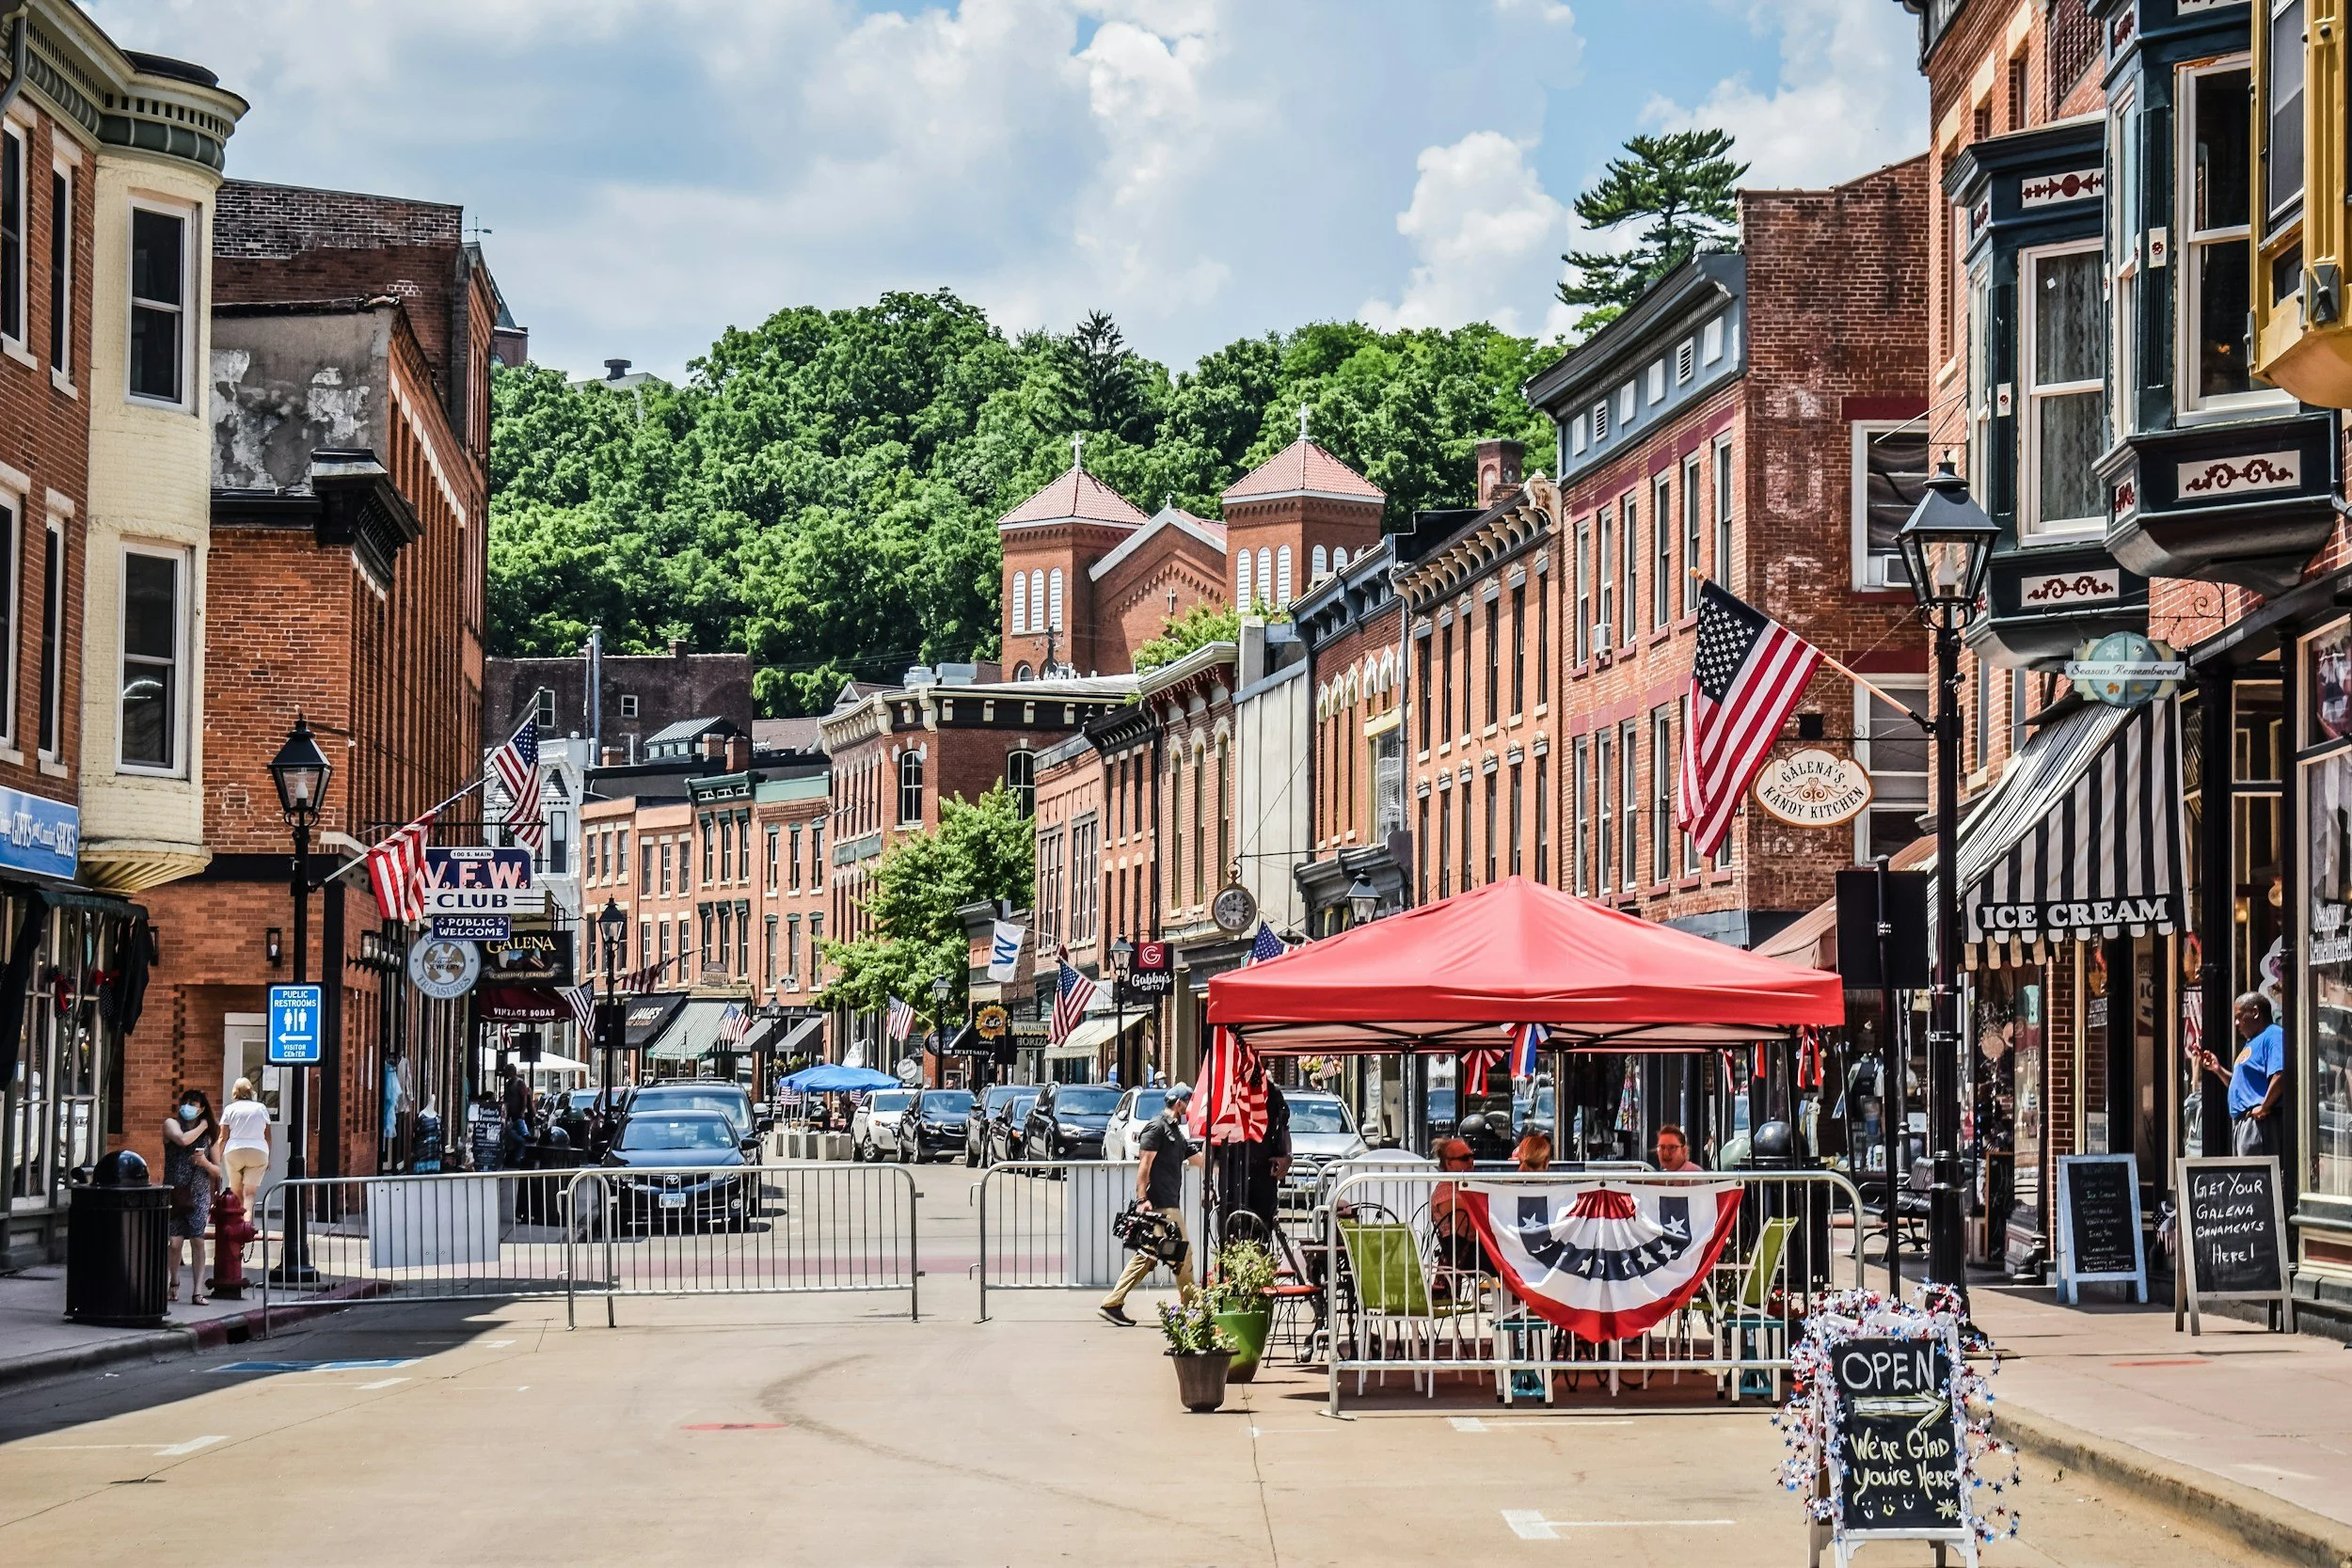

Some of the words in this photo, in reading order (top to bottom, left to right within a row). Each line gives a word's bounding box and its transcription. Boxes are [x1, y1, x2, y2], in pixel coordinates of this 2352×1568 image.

[2071, 664, 2110, 676] Seasons
[2112, 664, 2183, 676] Remembered
[1781, 761, 1845, 784] GALENA'S
[1762, 785, 1805, 816] KANDY
[1810, 785, 1865, 818] KITCHEN
[11, 811, 32, 848] GIFTS
[55, 821, 75, 858] SHOES
[437, 894, 508, 909] CLUB
[447, 918, 496, 927] PUBLIC
[1981, 905, 2038, 929] ICE
[2046, 897, 2169, 927] CREAM
[438, 927, 503, 937] WELCOME
[485, 936, 557, 955] GALENA
[416, 974, 471, 996] TREASURES
[1131, 971, 1172, 991] Gabby's
[282, 990, 309, 999] PUBLIC
[493, 1006, 527, 1017] VINTAGE
[530, 1008, 556, 1017] SODAS
[2194, 1175, 2225, 1199] GET
[2227, 1172, 2264, 1196] YOUR
[2196, 1203, 2254, 1220] GALENA
[2195, 1221, 2265, 1238] ORNAMENTS
[1841, 1340, 1936, 1391] OPEN
